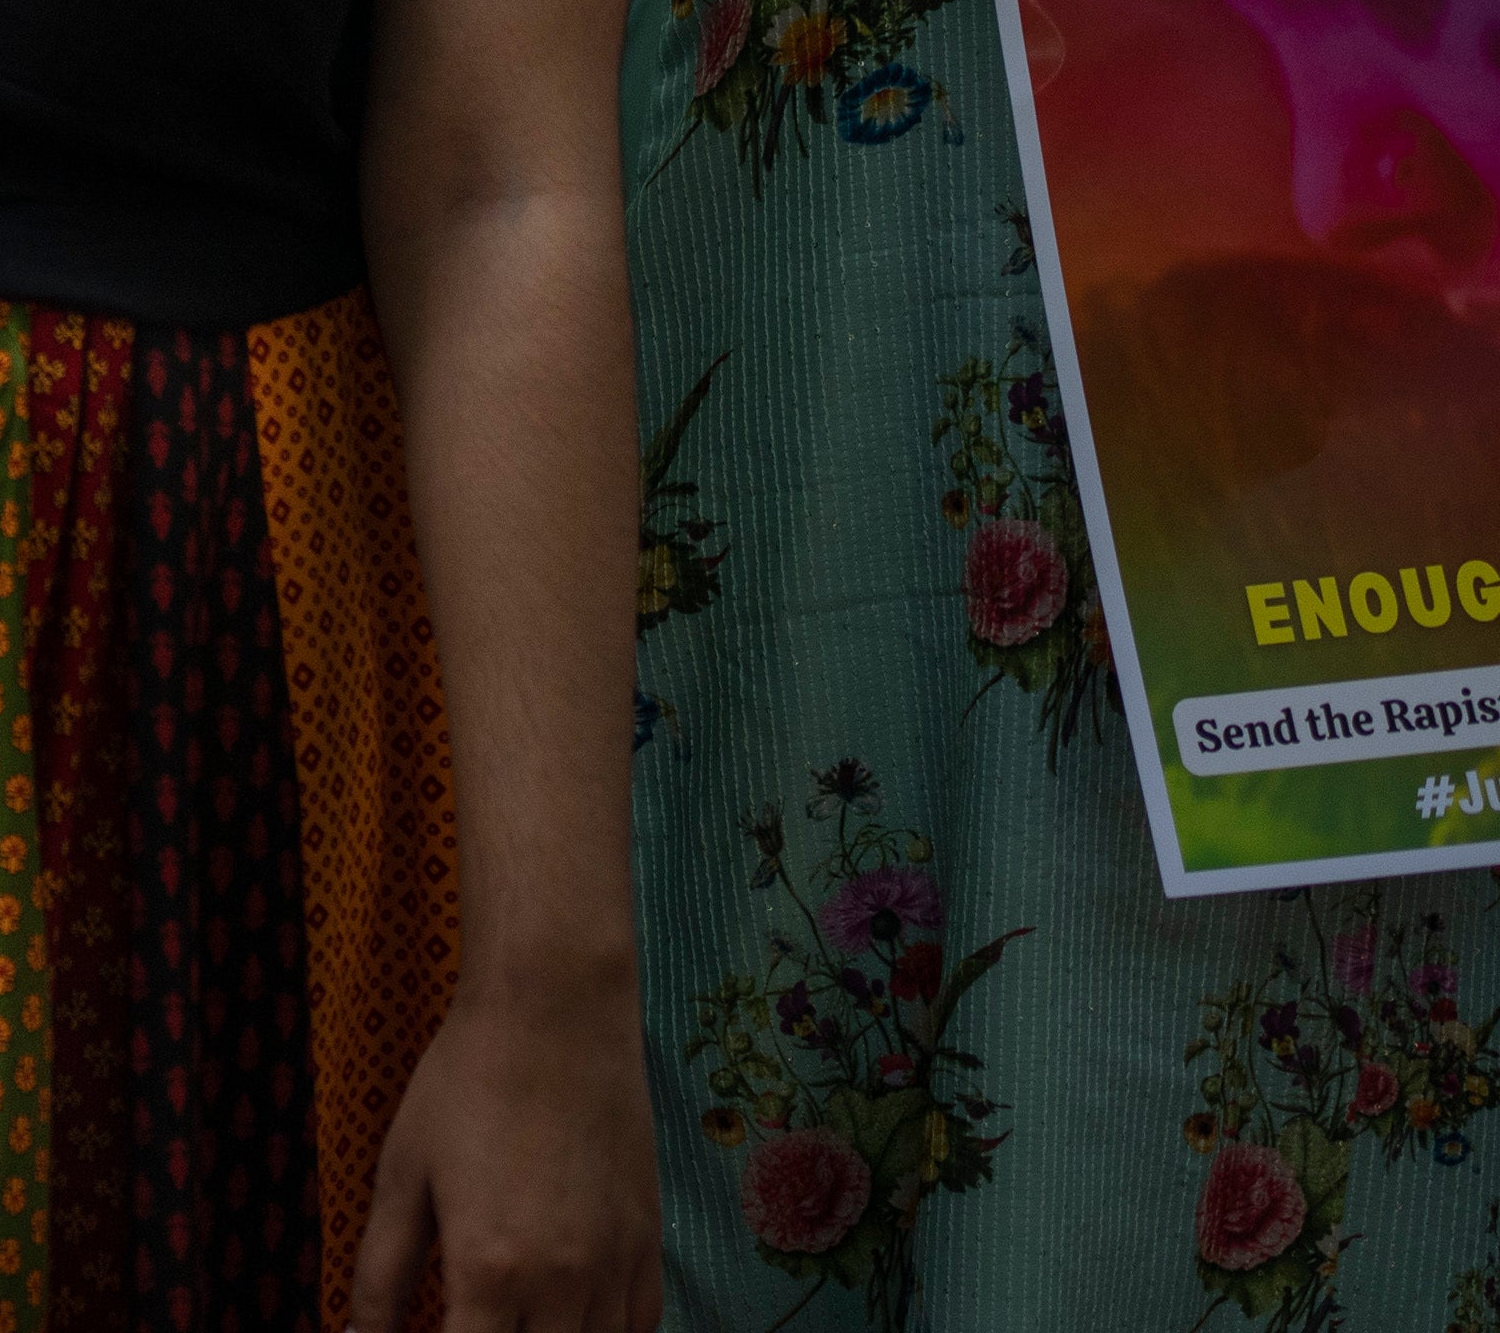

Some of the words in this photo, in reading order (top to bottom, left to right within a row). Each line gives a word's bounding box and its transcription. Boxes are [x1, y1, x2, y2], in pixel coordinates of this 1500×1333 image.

[1195, 708, 1300, 753] Send
[1305, 704, 1374, 738] the
[1381, 688, 1500, 736] Rapis
